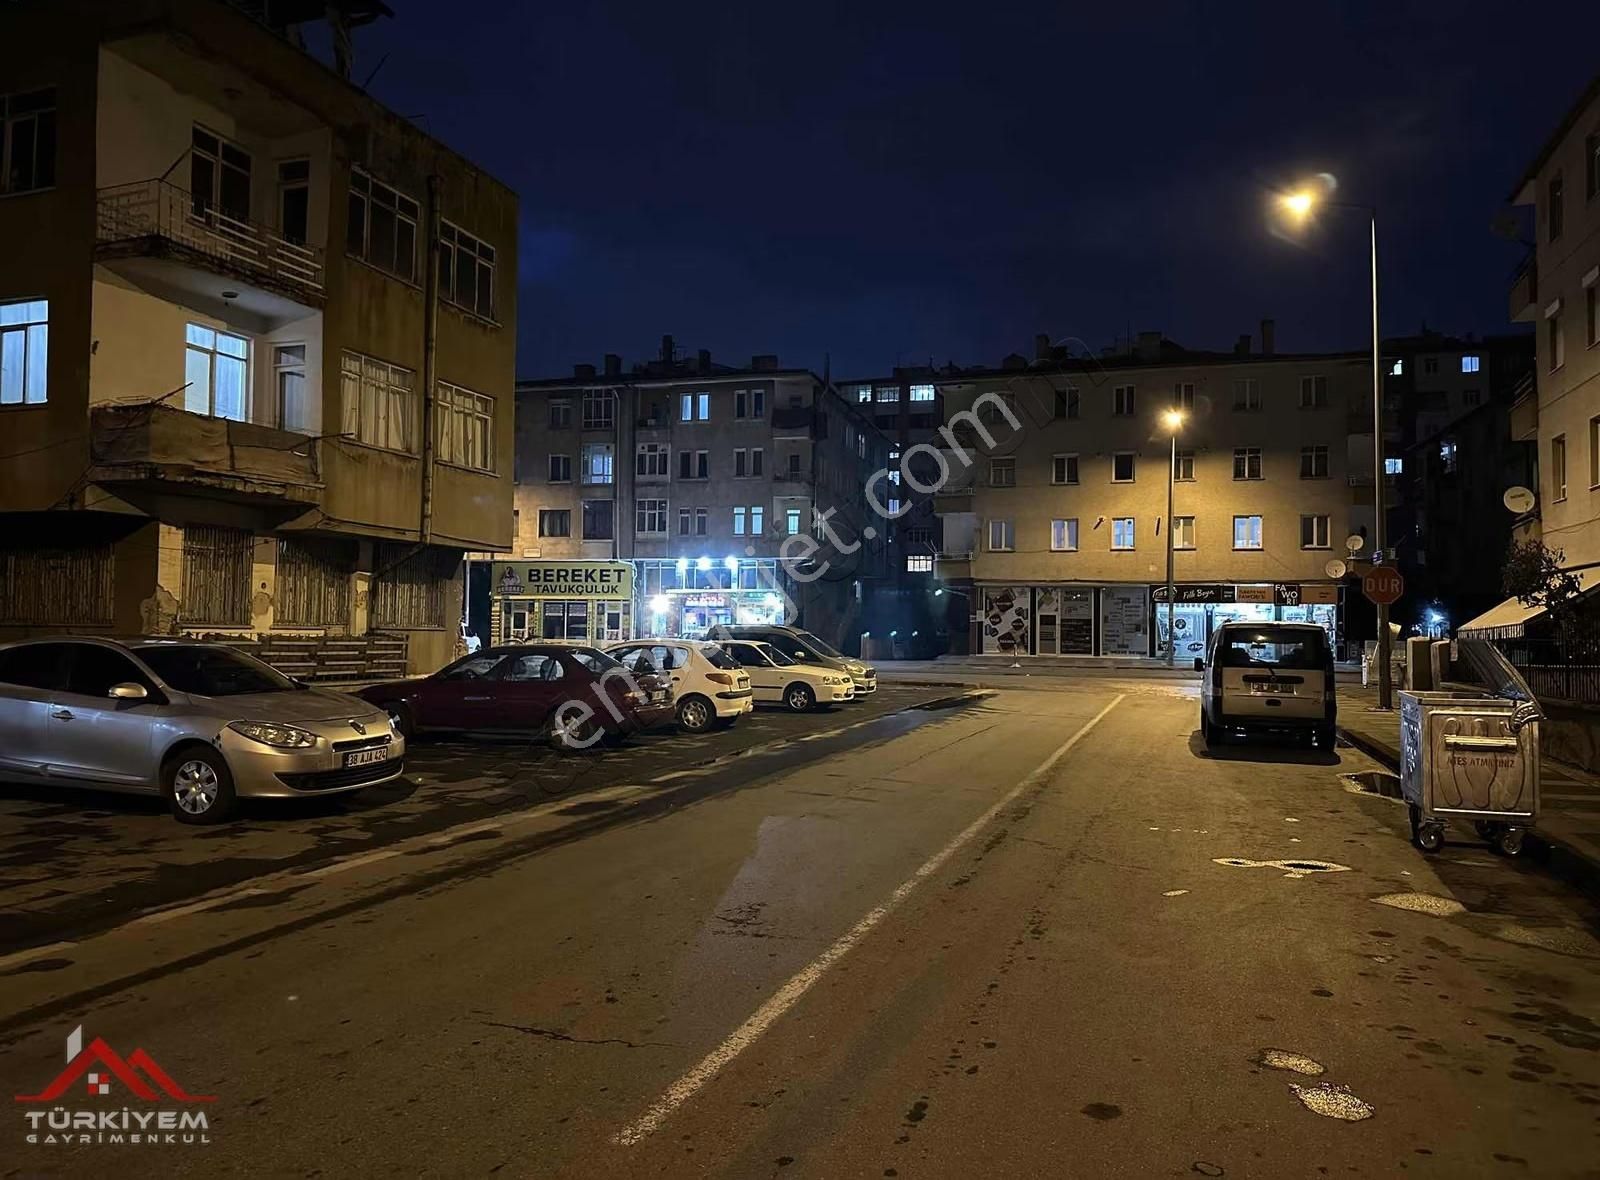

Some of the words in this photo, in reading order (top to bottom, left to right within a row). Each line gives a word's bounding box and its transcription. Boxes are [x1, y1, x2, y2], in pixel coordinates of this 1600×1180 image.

[528, 568, 626, 583] BEREKET
[535, 584, 619, 596] TAVUKÇULUK
[1366, 577, 1400, 593] DUR
[350, 754, 358, 765] 38
[360, 752, 373, 763] AJA
